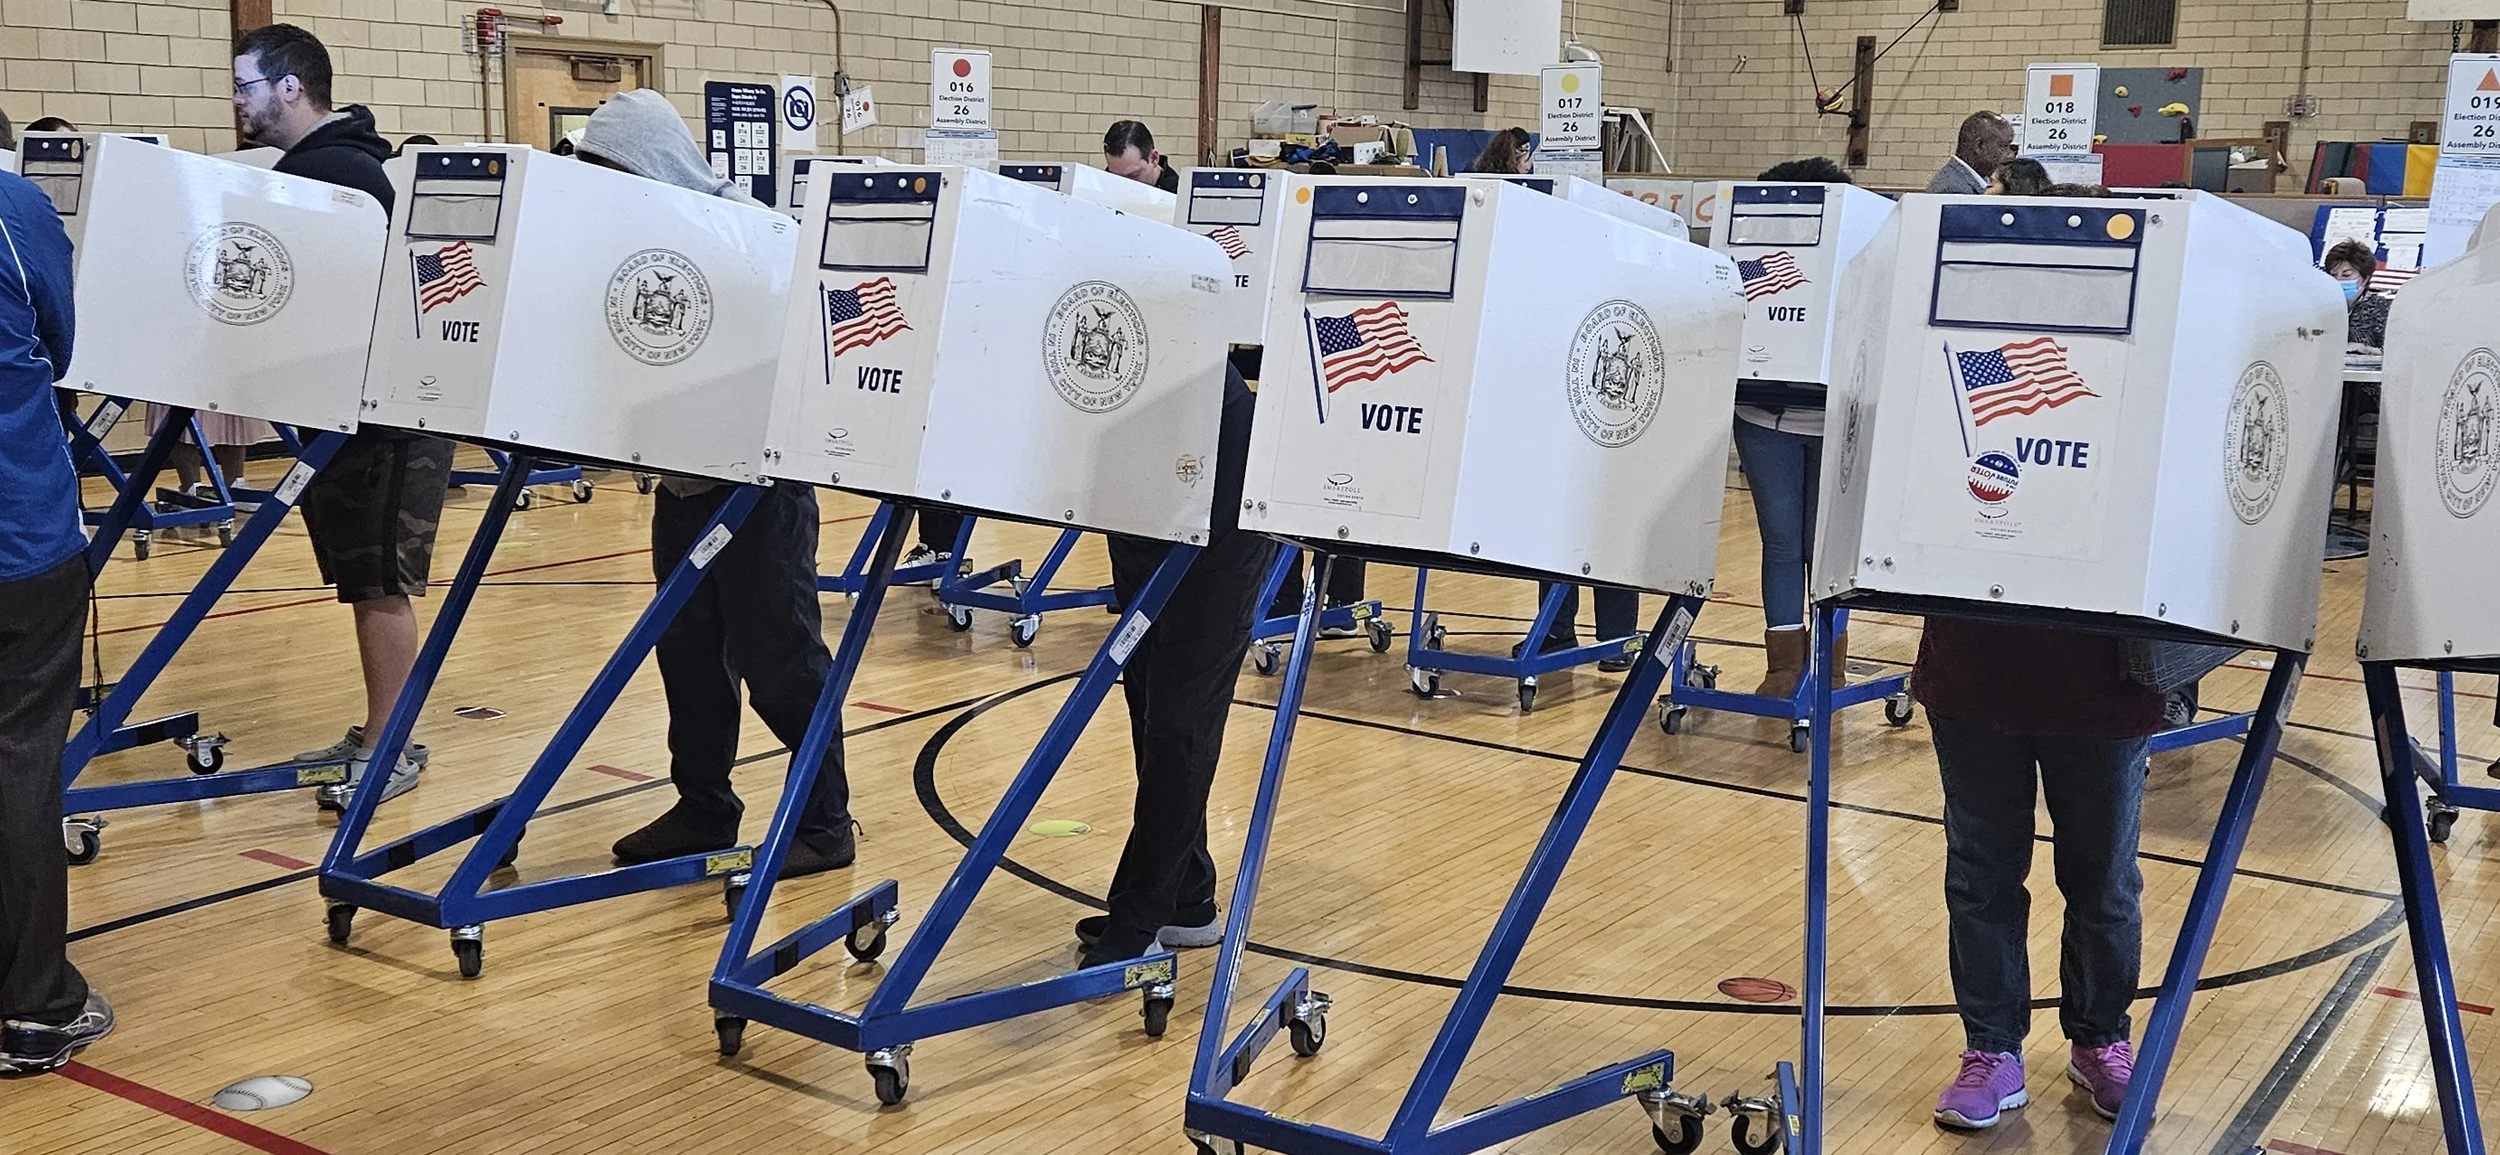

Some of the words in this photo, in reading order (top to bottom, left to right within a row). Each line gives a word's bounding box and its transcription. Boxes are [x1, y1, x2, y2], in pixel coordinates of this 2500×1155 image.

[950, 81, 974, 93] 016
[1558, 98, 1582, 109] 017
[2045, 102, 2074, 113] 018
[2471, 96, 2500, 109] 019
[954, 105, 970, 116] 26
[936, 117, 965, 125] Assembly
[2454, 113, 2487, 121] Election
[1562, 122, 1579, 132] 26
[2473, 125, 2495, 138] 26
[2048, 128, 2067, 140] 26
[2027, 143, 2061, 152] Assembly
[2447, 141, 2487, 150] Assembly
[1234, 275, 1249, 288] TE
[1768, 306, 1806, 322] VOTE
[442, 320, 480, 343] VOTE
[858, 366, 903, 394] VOTE
[1361, 403, 1423, 434] VOTE
[2016, 437, 2089, 469] VOTE
[1970, 465, 1995, 481] VOTER
